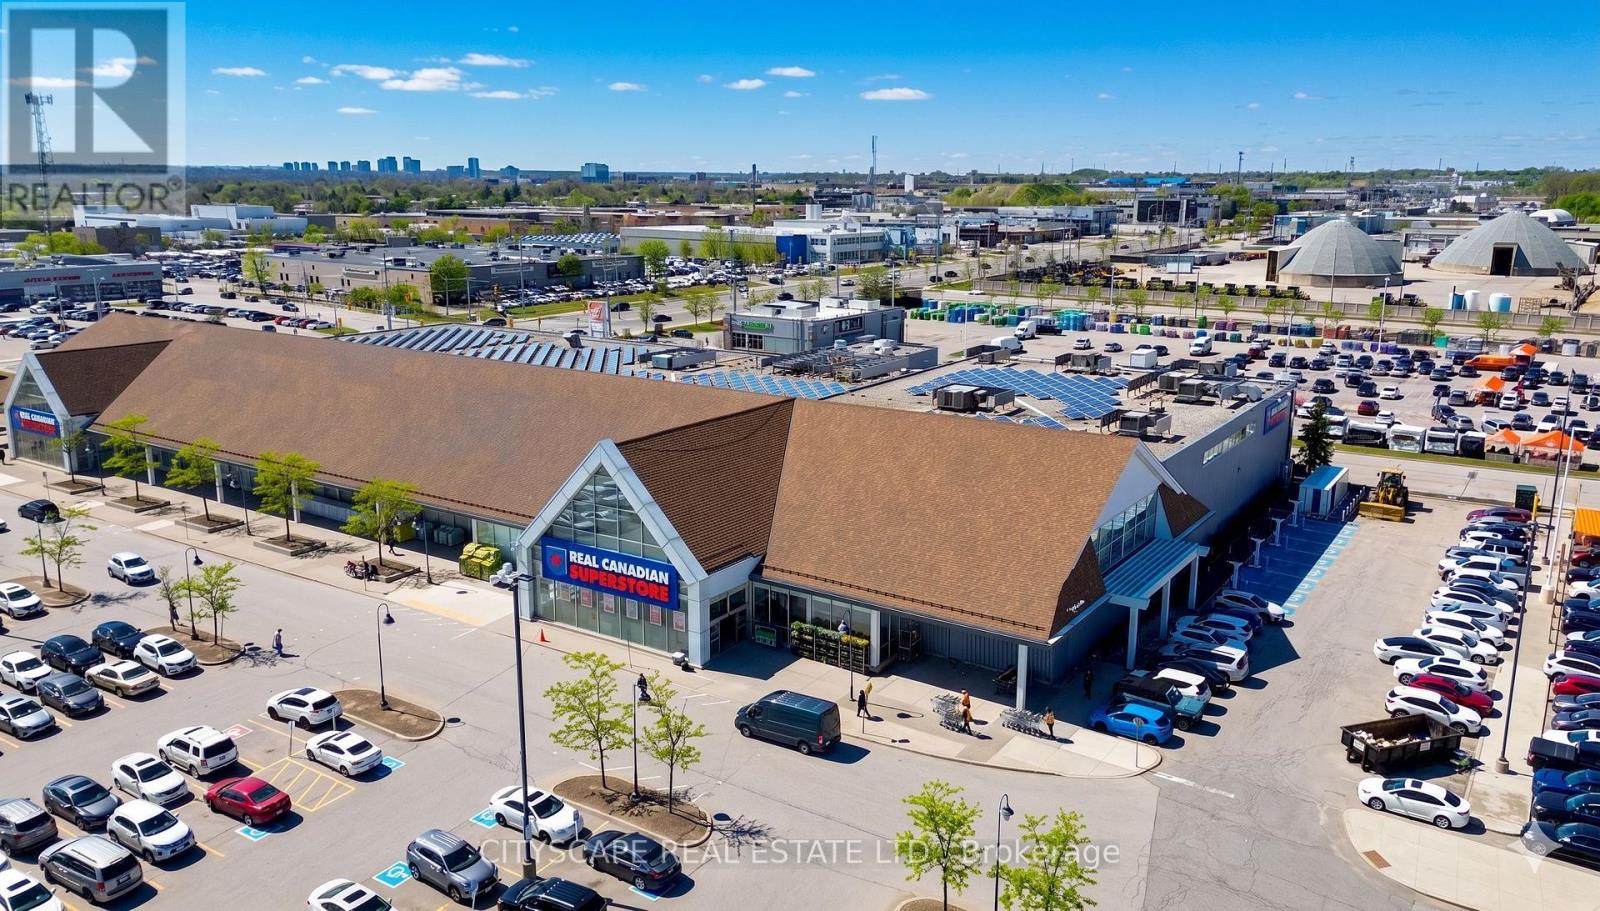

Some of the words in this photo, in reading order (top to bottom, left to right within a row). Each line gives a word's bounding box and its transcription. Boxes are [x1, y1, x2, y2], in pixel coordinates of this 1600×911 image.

[569, 551, 599, 569] REAL
[602, 558, 669, 585] CANADIAN
[569, 564, 670, 603] SUPERSTORE
